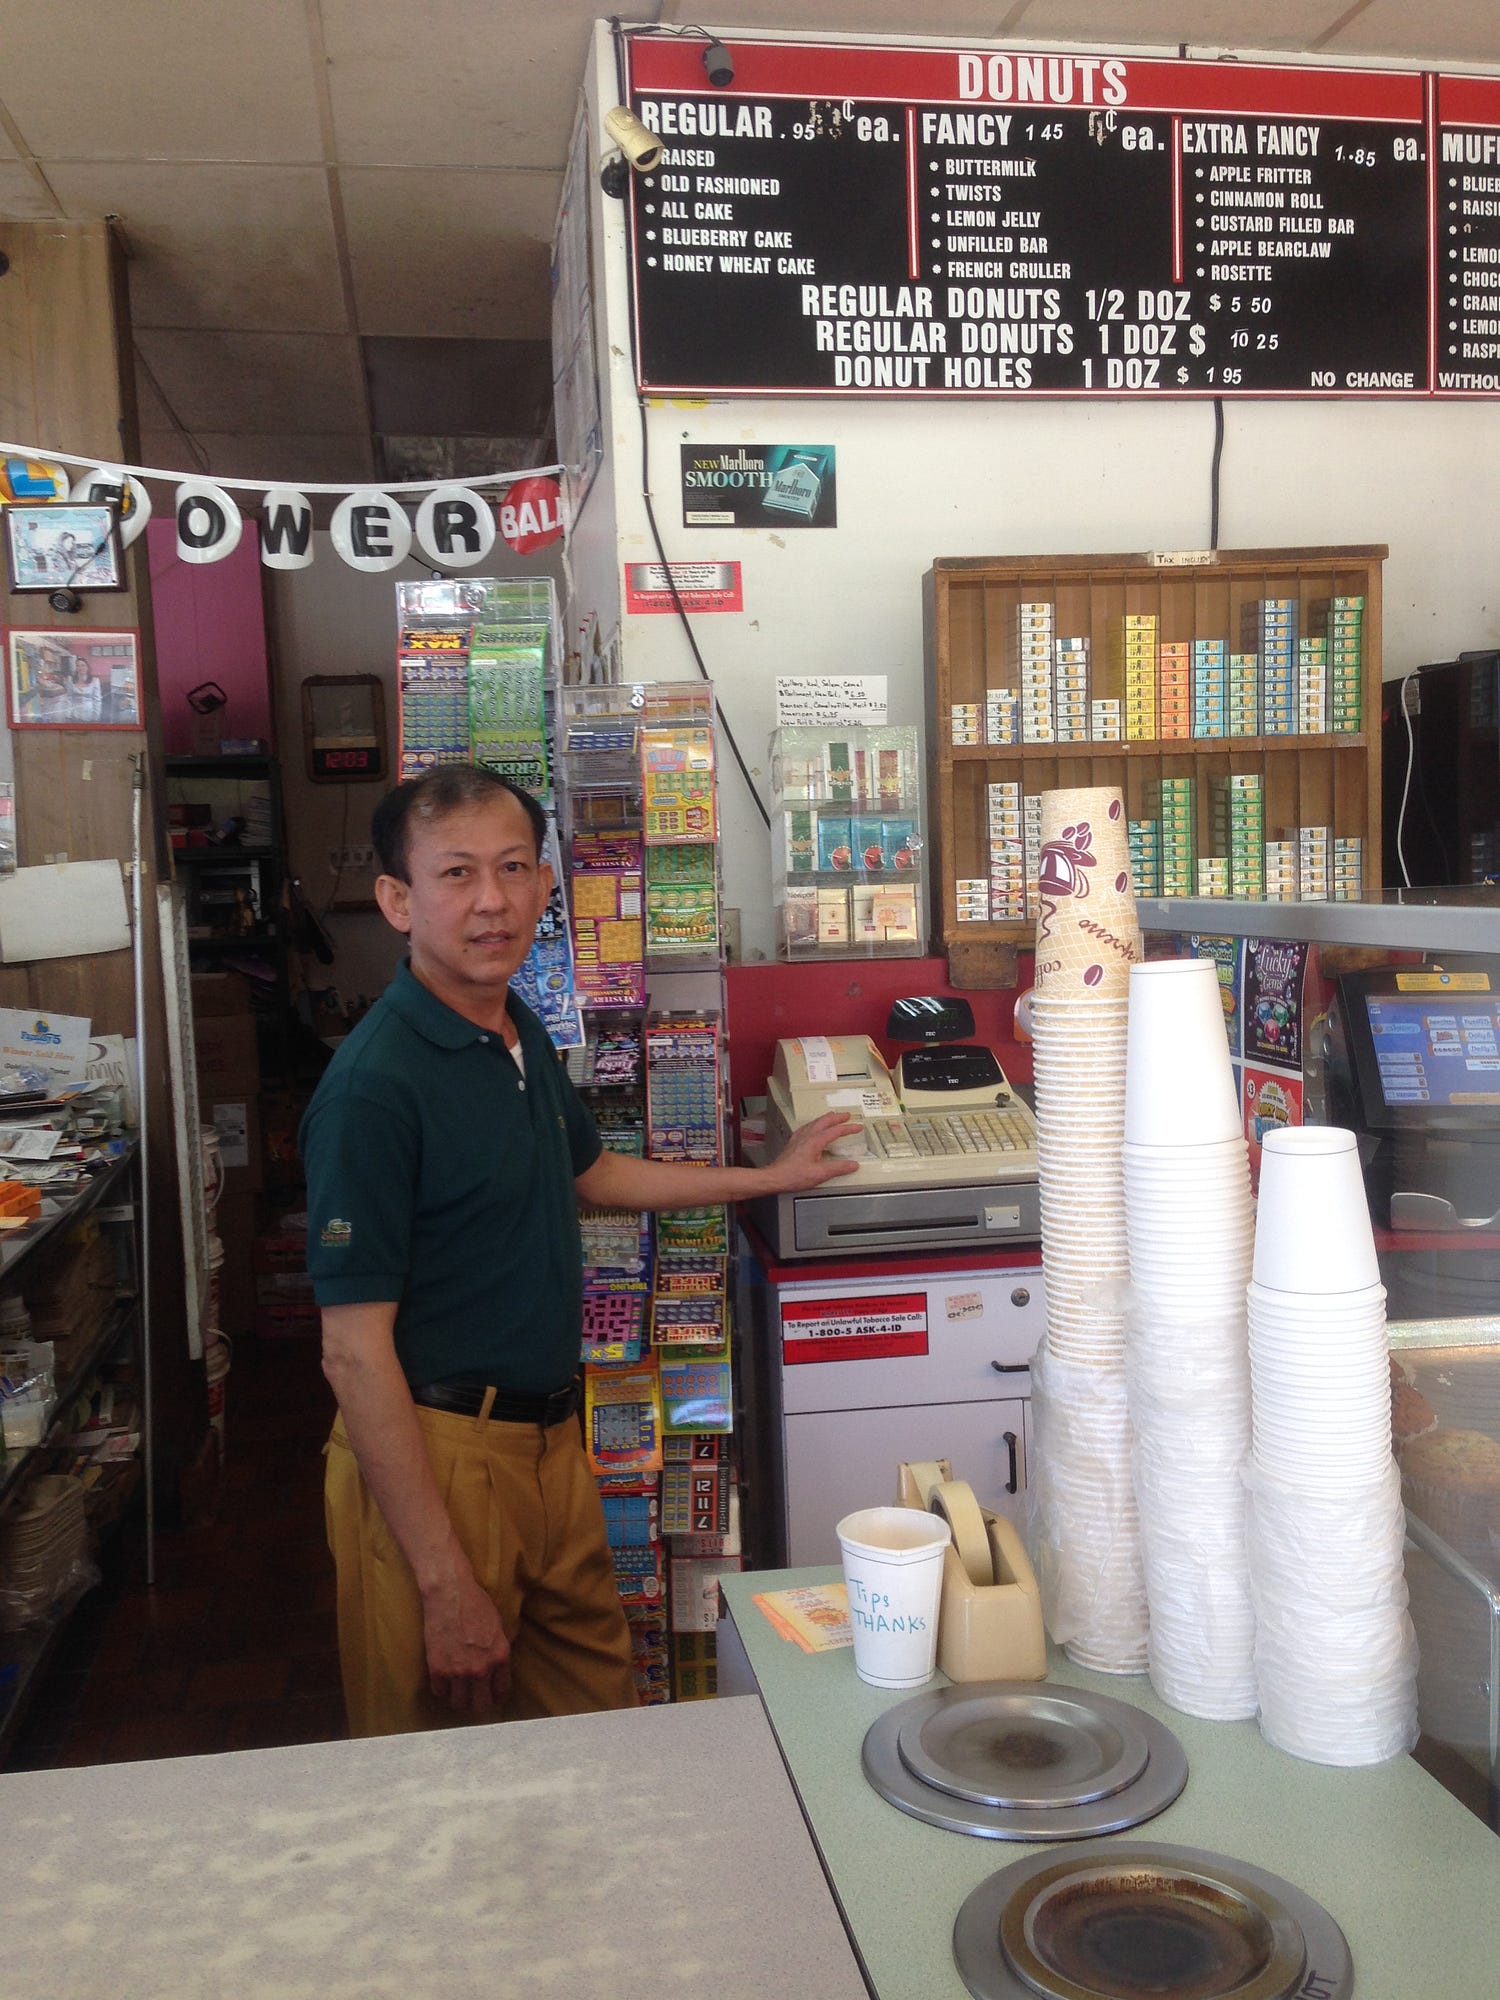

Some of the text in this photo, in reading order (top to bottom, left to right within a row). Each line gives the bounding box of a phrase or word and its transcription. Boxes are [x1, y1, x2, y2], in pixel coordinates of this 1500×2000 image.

[958, 54, 1127, 105] DONUTS
[641, 101, 773, 139] REGULAR
[857, 117, 900, 142] ea.
[923, 113, 1012, 145] FANCY
[1122, 126, 1165, 150] ea.
[1183, 123, 1248, 154] EXTRA
[1257, 125, 1319, 156] FANCY
[1393, 136, 1426, 161] ea.
[661, 148, 716, 168] RAISED
[945, 159, 1037, 177] BUTTERMILK
[1210, 166, 1312, 185] APPLE FRITTER
[661, 175, 780, 196] OLD FASHIONED
[945, 185, 1001, 202] TWISTS
[1210, 190, 1324, 210] CINNAMON ROLL
[1463, 199, 1500, 217] RAISI
[662, 202, 733, 221] ALL CAKE
[947, 210, 1041, 228] LEMON JELLY
[1211, 215, 1355, 235] CUSTARD FILLED BAR
[663, 228, 793, 249] BLUEBERRY CAKE
[947, 236, 1048, 254] UNFILLED BAR
[1211, 240, 1331, 258] APPLE BEARCLAW
[1463, 247, 1500, 264] LEMO
[663, 254, 815, 275] HONEY WHEAT CAKE
[948, 262, 1070, 279] FRENCH CRULLER
[1211, 265, 1272, 282] ROSETTE
[802, 285, 932, 318] REGULAR
[947, 287, 1061, 320] DONUTS
[1085, 288, 1125, 322] 1/2
[1138, 290, 1191, 321] DOZ
[1463, 318, 1500, 335] LEMO
[816, 320, 946, 353] REGULAR
[961, 322, 1074, 355] DONUTS
[1098, 325, 1109, 355] 1
[1123, 324, 1176, 355] DOZ
[1189, 323, 1206, 357] $
[834, 356, 931, 388] DONUT
[945, 357, 1032, 388] HOLES
[1082, 359, 1092, 389] 1
[1107, 358, 1160, 389] DOZ
[1311, 372, 1335, 387] NO
[1346, 372, 1414, 388] CHANGE
[694, 449, 764, 471] NEW Marlboro
[685, 471, 774, 488] SMOOTH
[640, 592, 658, 600] Report
[1259, 945, 1292, 980] Lucky
[1263, 976, 1283, 990] Gems
[2, 1046, 33, 1056] Winner
[609, 1283, 648, 1291] TRIPLING
[788, 1321, 796, 1329] To
[797, 1320, 820, 1330] Report
[830, 1317, 863, 1327] Unlawful
[863, 1316, 891, 1324] Tobacco
[892, 1314, 906, 1322] Sale
[907, 1313, 922, 1321] Call:
[808, 1324, 902, 1338] 1-800-5 ASK-4-ID
[849, 1578, 890, 1613] Tips
[852, 1607, 927, 1634] THANKS
